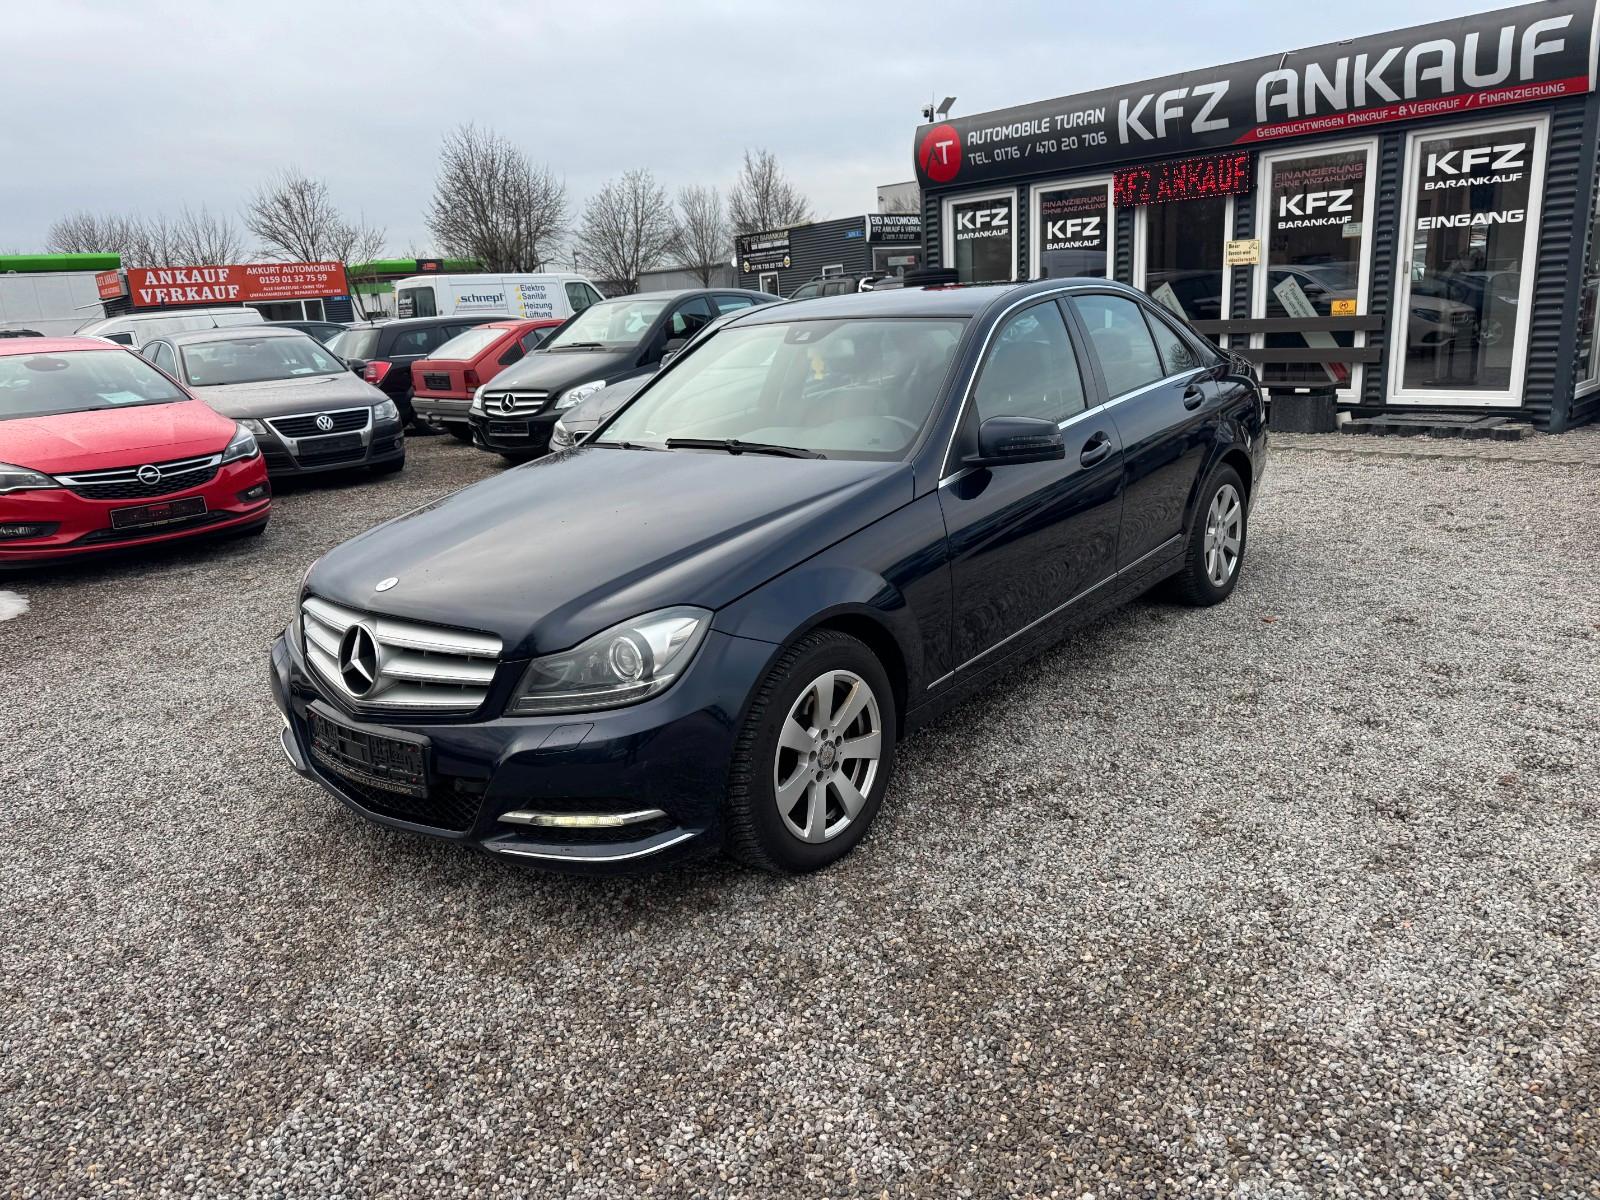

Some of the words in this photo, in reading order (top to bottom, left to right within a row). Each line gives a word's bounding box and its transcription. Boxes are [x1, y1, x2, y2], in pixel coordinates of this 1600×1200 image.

[1118, 80, 1230, 144] KFZ
[1256, 14, 1574, 122] ANKAUF
[968, 118, 1050, 146] AUTOMOBILE
[1055, 107, 1106, 130] TURAN
[968, 152, 992, 166] TEL.
[994, 146, 1020, 162] 0176
[1024, 144, 1032, 157] /
[1036, 139, 1057, 154] 470
[1061, 136, 1078, 150] 20
[1082, 131, 1107, 147] 706
[1426, 142, 1526, 176] KFZ
[1275, 163, 1364, 180] FINANZIERUNG
[1275, 180, 1300, 188] OHNE
[1303, 172, 1362, 185] ANZAHLUNG
[1113, 171, 1151, 207] KFZ
[1157, 156, 1246, 199] ANKAUF
[1424, 173, 1522, 190] BARANKAUF
[1042, 194, 1106, 209] FINANZIERUNG
[1064, 202, 1106, 213] ANZAHLUNG
[1280, 188, 1354, 217] KFZ
[957, 207, 1008, 230] KFZ
[1278, 216, 1352, 230] BARANKAUF
[1418, 210, 1525, 230] EINGANG
[957, 228, 1008, 240] BARANKAUF
[1048, 216, 1100, 240] KFZ
[1046, 238, 1100, 250] BARANKAUF
[144, 268, 230, 286] ANKAUF
[246, 266, 280, 275] AKKURT
[282, 264, 336, 274] AUTOMOBILE
[260, 276, 280, 284] 0159
[282, 275, 292, 283] 01
[139, 284, 240, 303] VERKAUF
[460, 293, 504, 304] schnepf
[524, 302, 553, 311] Heizung
[525, 311, 552, 319] Lüftung
